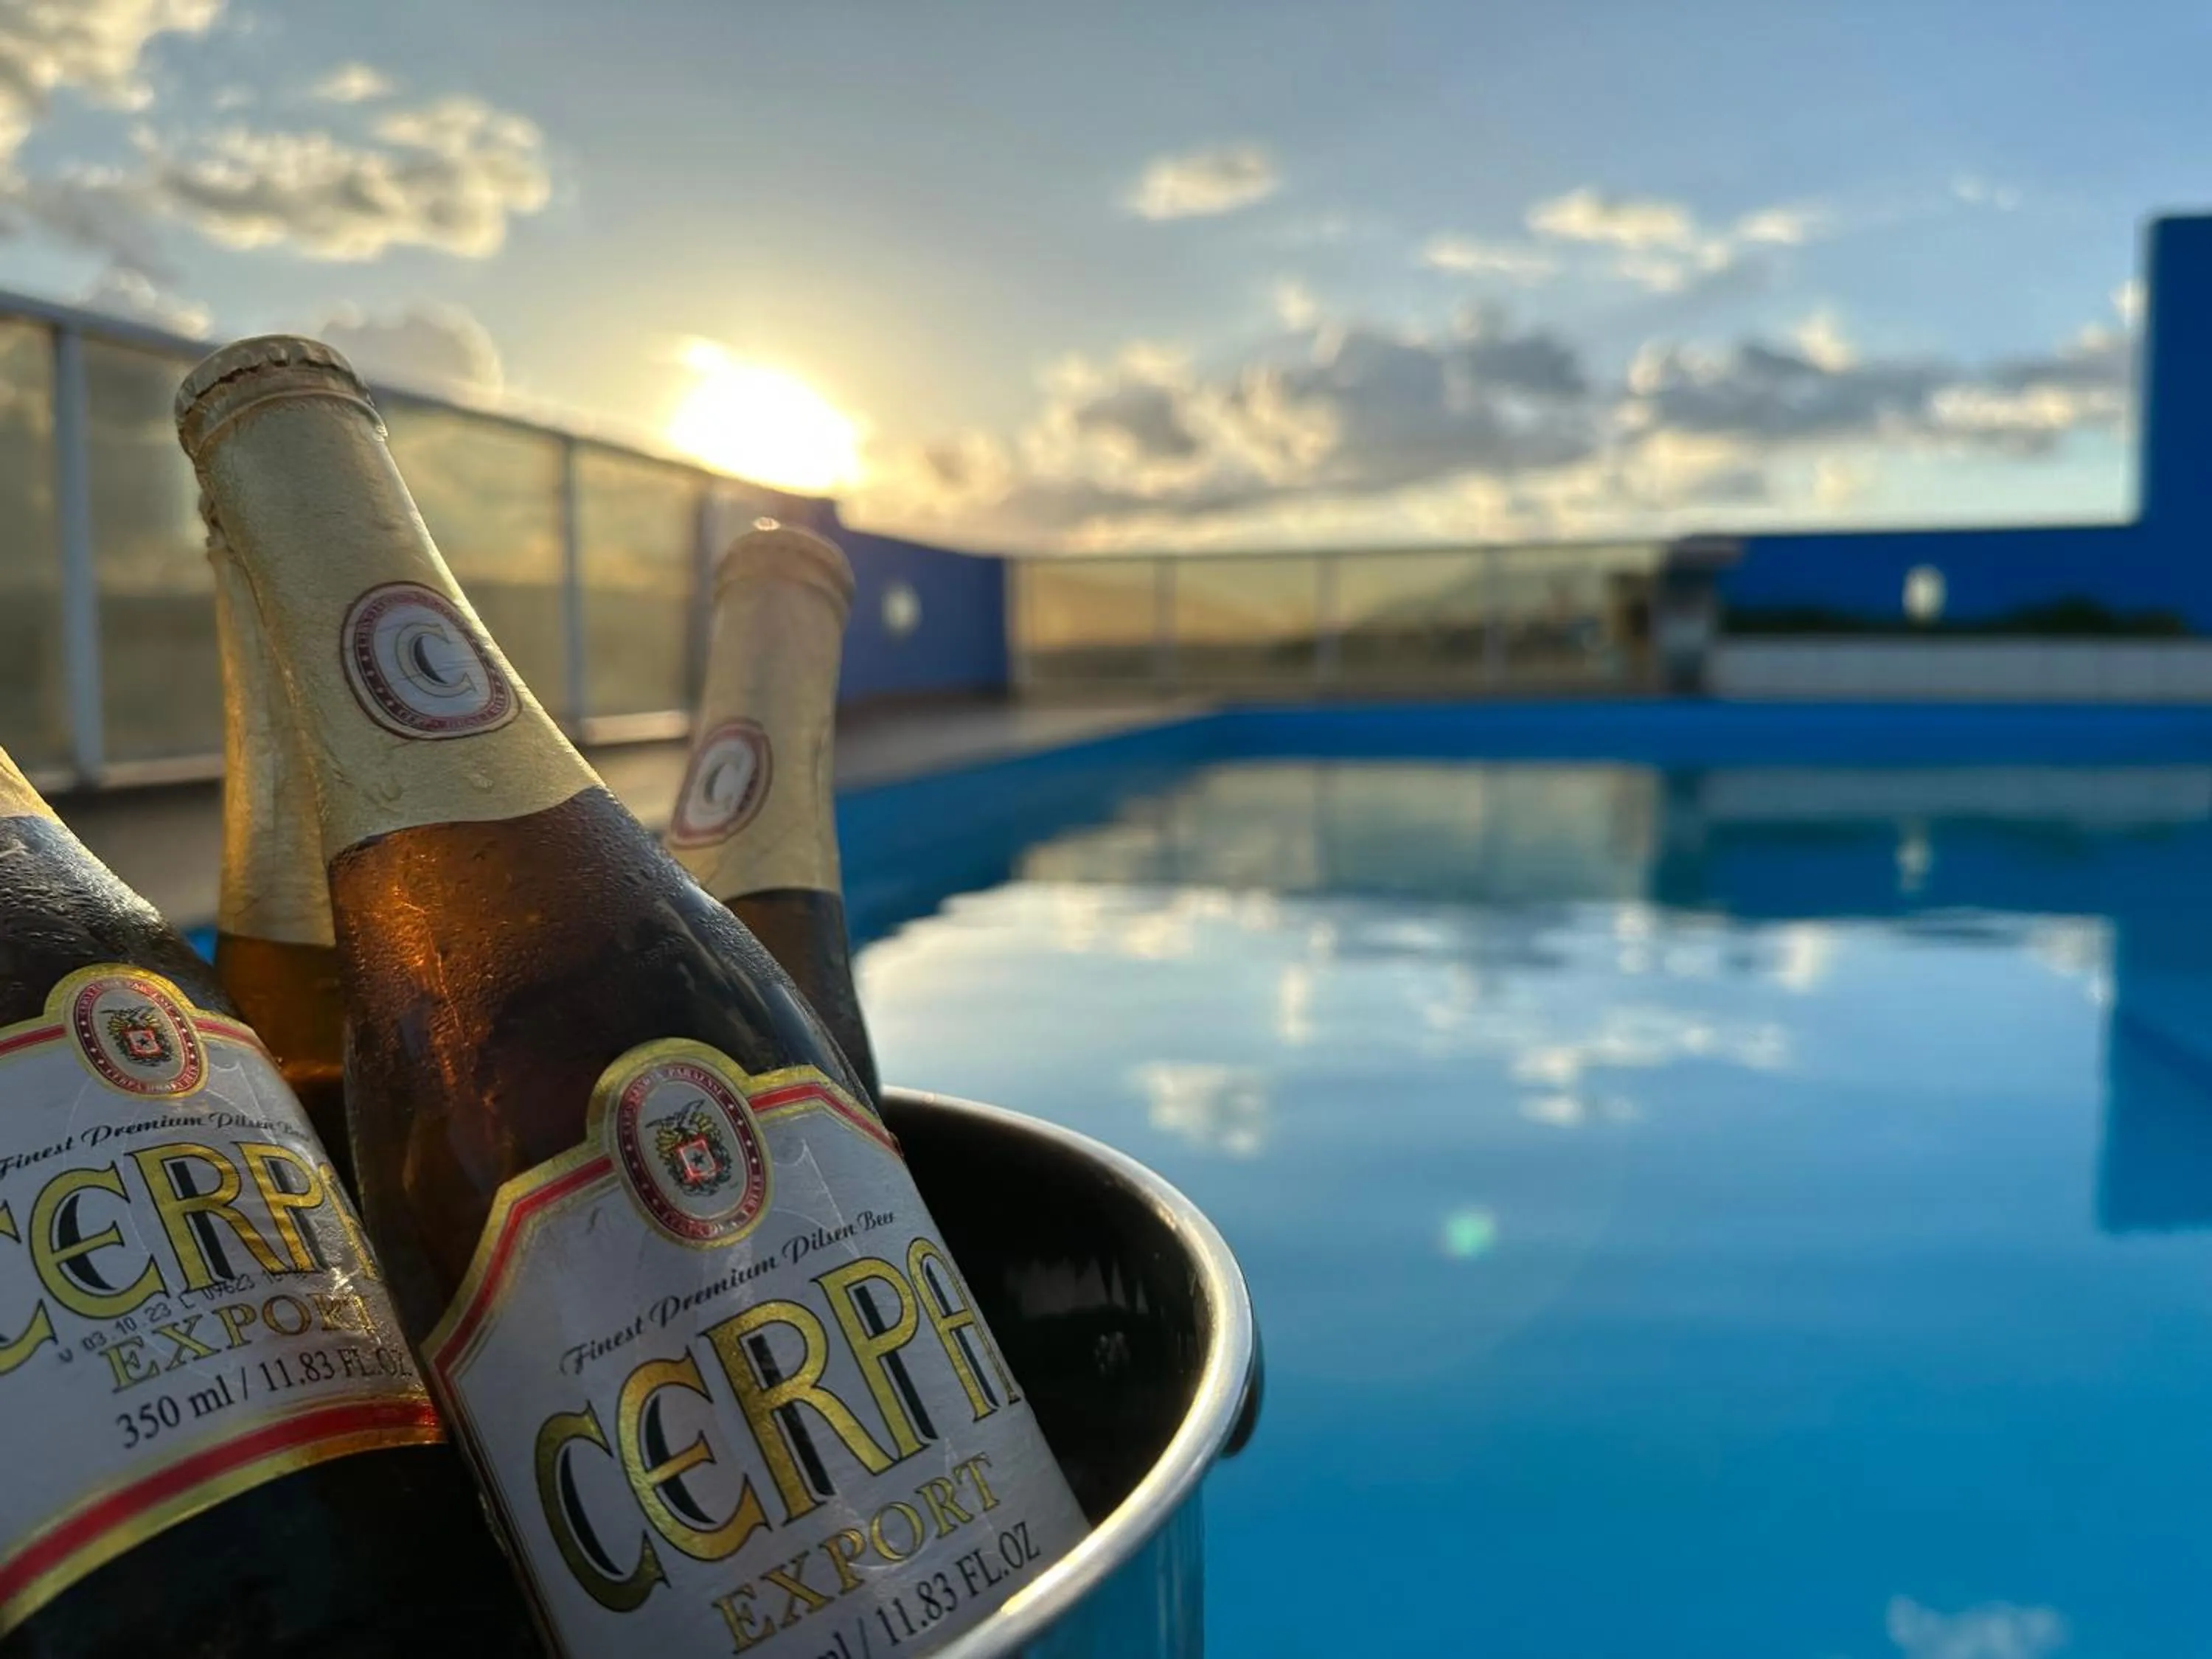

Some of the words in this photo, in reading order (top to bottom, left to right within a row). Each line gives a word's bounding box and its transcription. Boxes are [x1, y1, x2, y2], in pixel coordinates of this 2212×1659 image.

[394, 622, 477, 698] C
[0, 1136, 75, 1178] Finest
[80, 1116, 206, 1148] Premium
[559, 1316, 645, 1377] Finest
[649, 1253, 779, 1328] Premium
[782, 1222, 858, 1265] Pilsen
[857, 1210, 897, 1234] Beer
[115, 1396, 181, 1450] 350
[186, 1375, 235, 1419] ml
[240, 1366, 251, 1400] /
[259, 1350, 335, 1392] 11.83
[534, 1236, 1021, 1613] CERPA
[711, 1451, 1001, 1655] EXPORT
[874, 1571, 958, 1646] 11.83
[955, 1520, 1042, 1599] FL.OZ
